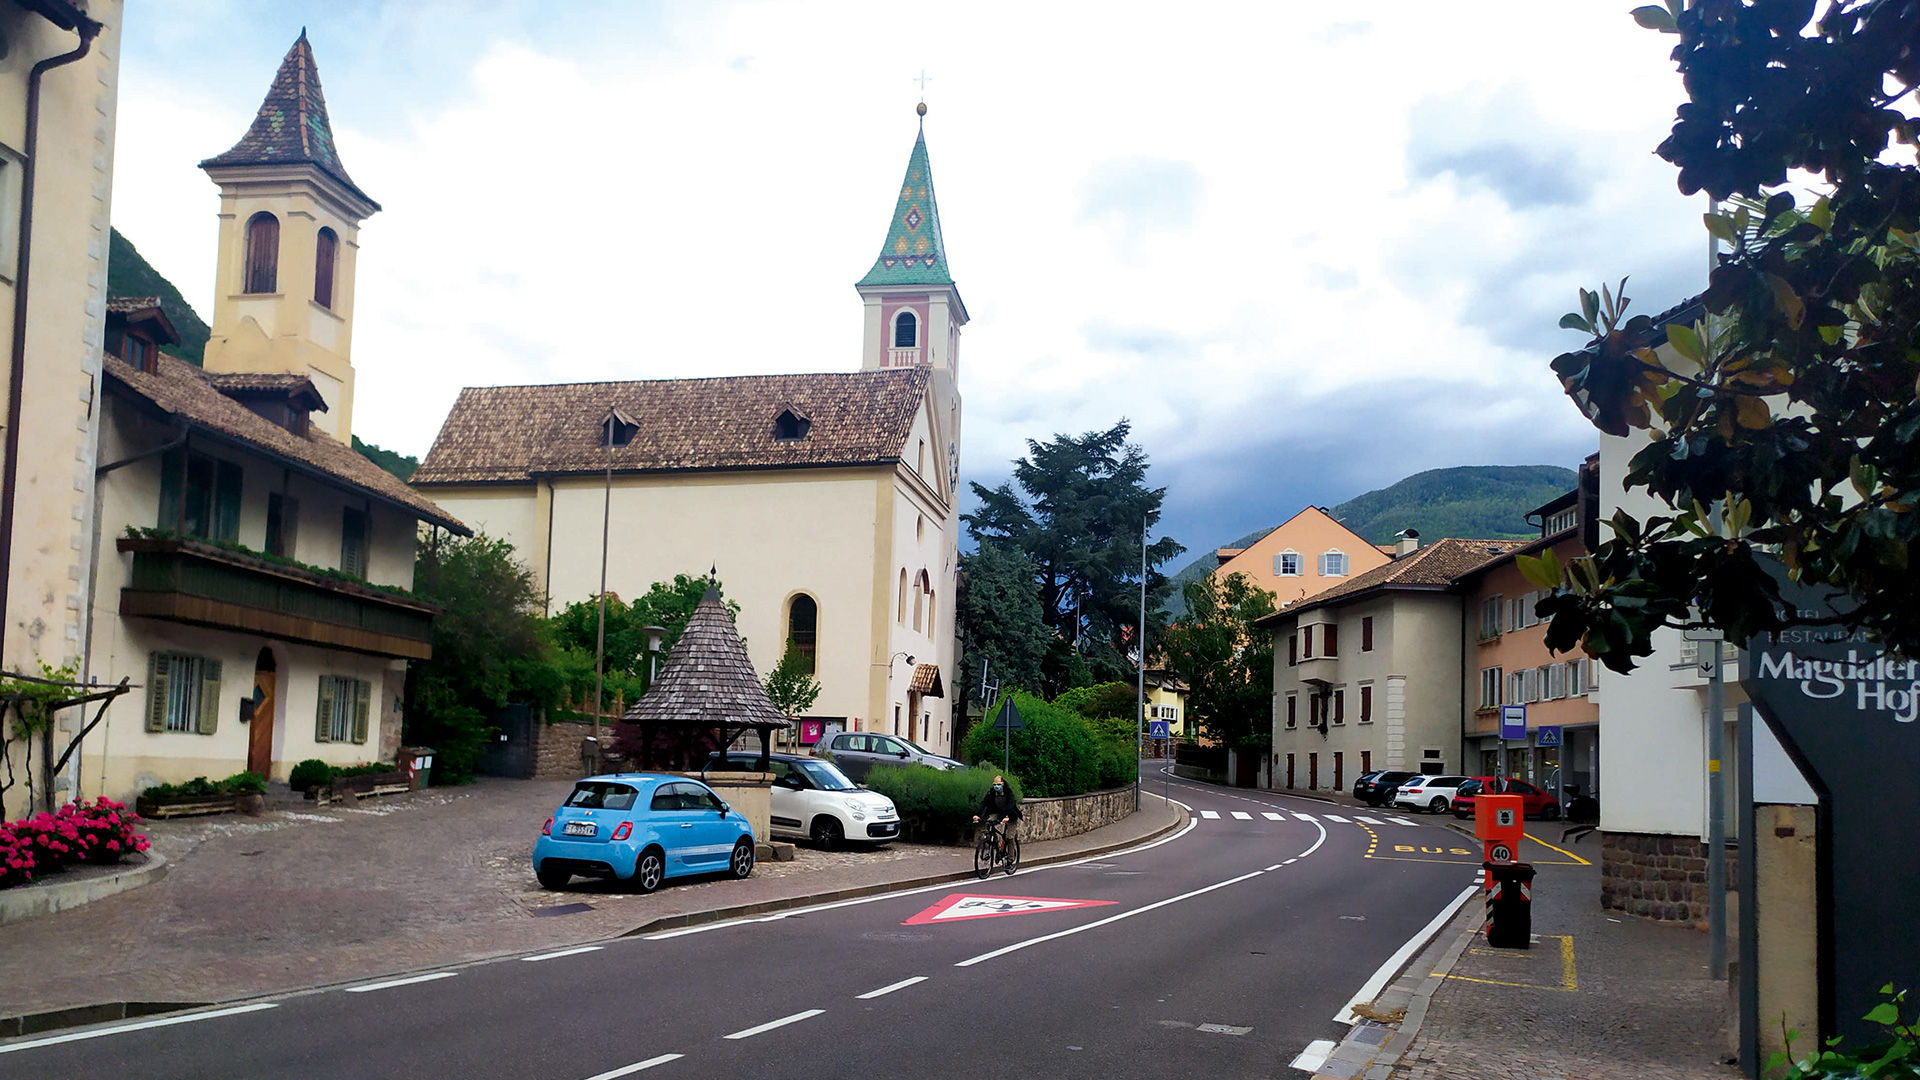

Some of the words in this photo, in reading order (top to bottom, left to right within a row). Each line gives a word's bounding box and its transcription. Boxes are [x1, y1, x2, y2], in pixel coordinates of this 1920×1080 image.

[1857, 680, 1920, 723] Hof
[1394, 845, 1472, 855] BUS
[1494, 848, 1508, 860] 40
